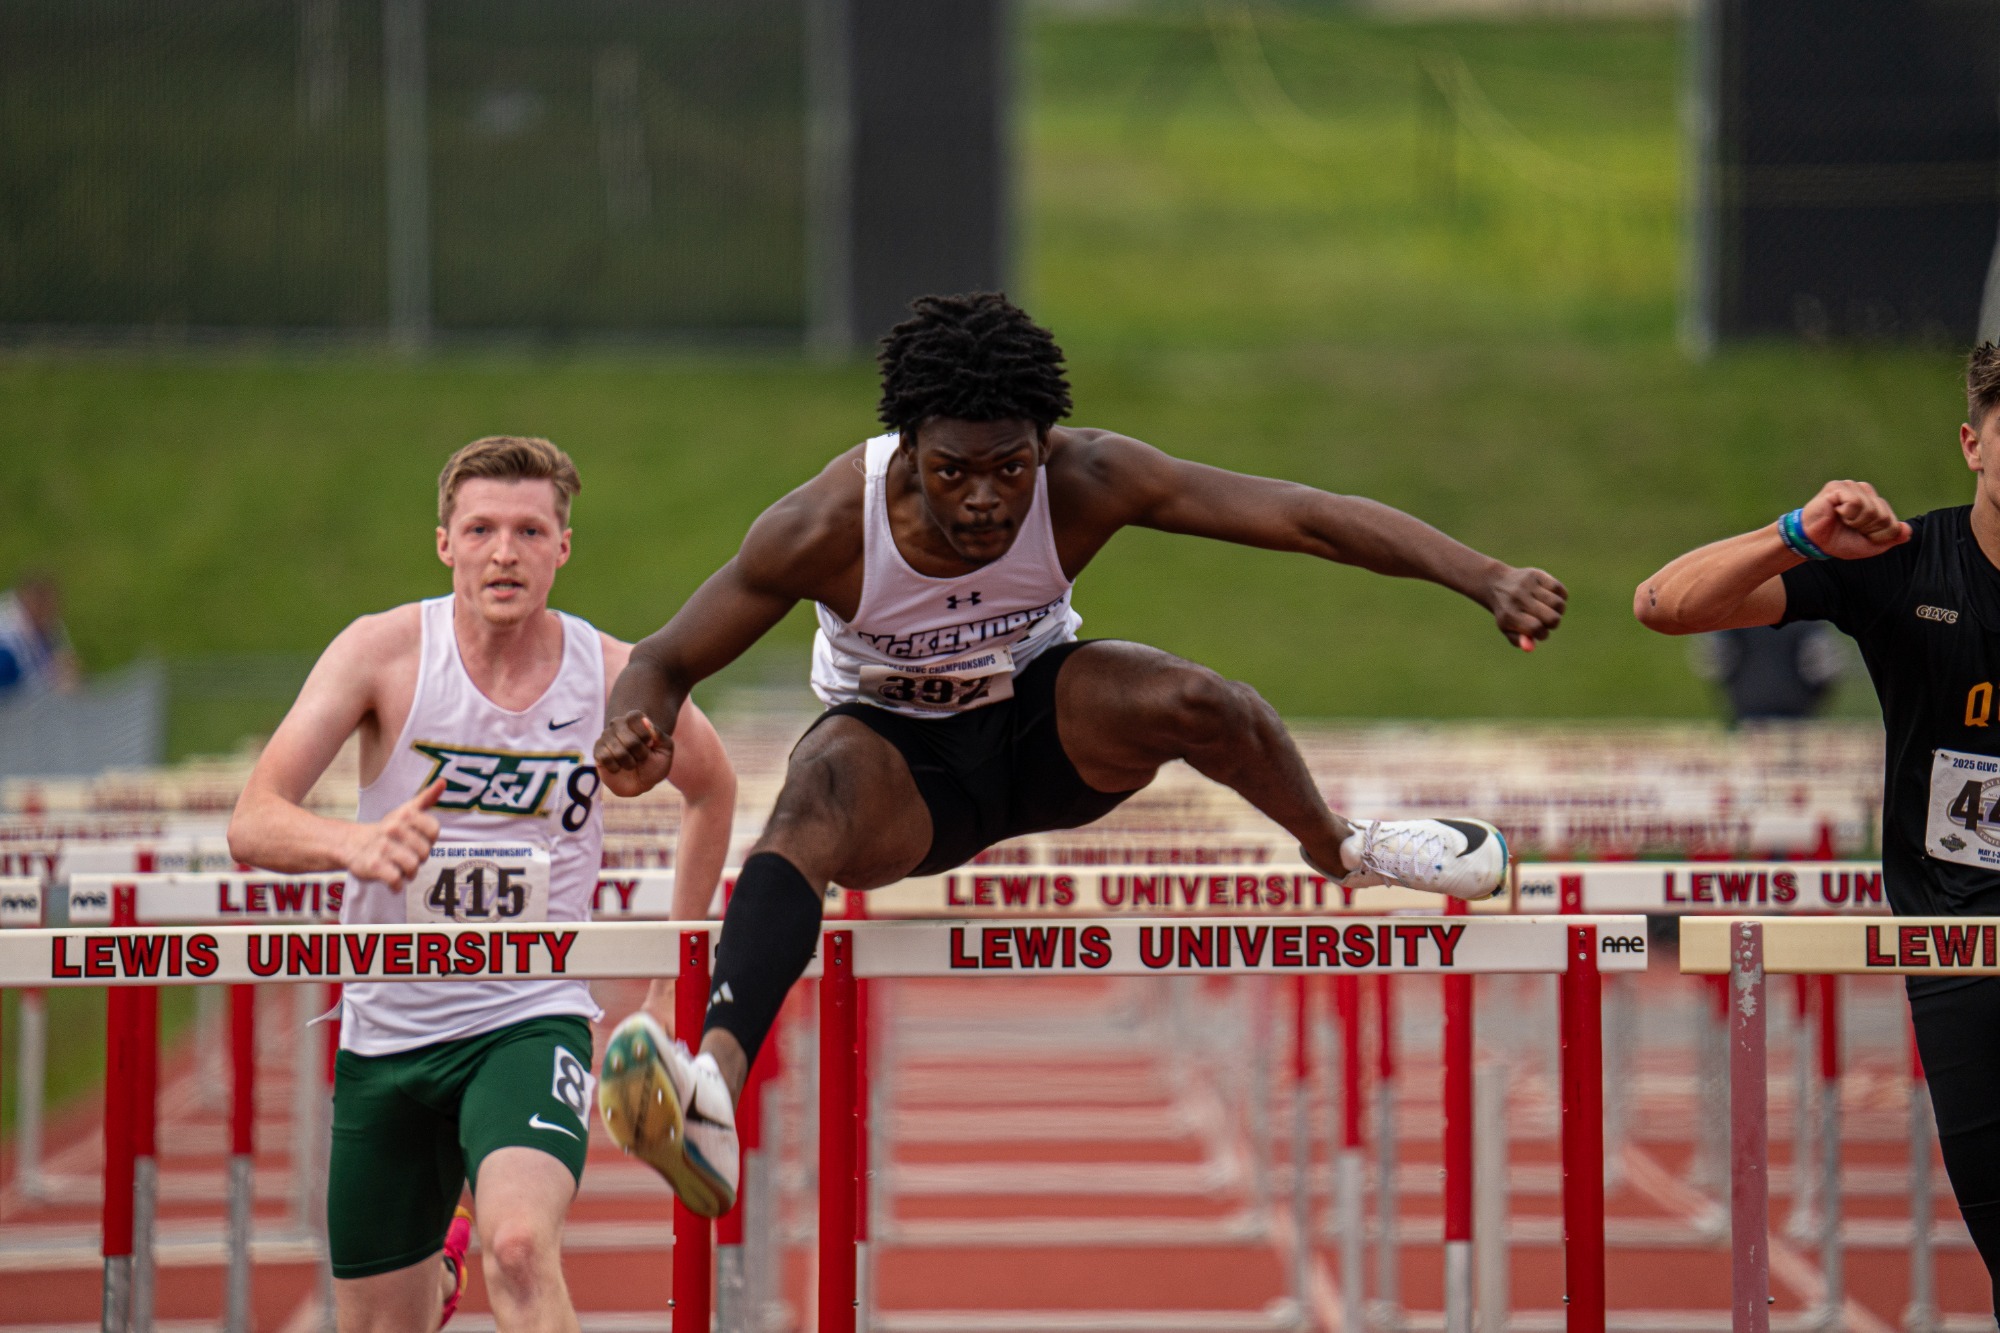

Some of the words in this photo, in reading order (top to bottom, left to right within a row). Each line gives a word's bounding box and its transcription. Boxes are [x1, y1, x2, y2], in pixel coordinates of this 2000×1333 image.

[1916, 605, 1958, 624] GLVC
[929, 654, 996, 675] CHAMPIONSHIPS
[884, 676, 989, 704] 392
[1965, 682, 2000, 727] Q
[438, 751, 570, 809] S&T
[1953, 758, 1975, 770] 2025
[1977, 762, 1998, 773] GLVC
[562, 766, 600, 832] 8
[469, 847, 533, 857] CHAMPIONSHIPS
[1978, 848, 1991, 857] MAY
[430, 867, 526, 917] 415
[946, 873, 1077, 907] LEWIS
[1664, 870, 1797, 905] LEWIS
[52, 934, 219, 978] LEWIS
[247, 930, 578, 976] UNIVERSITY
[950, 925, 1112, 969] LEWIS
[1139, 924, 1467, 968] UNIVERSITY
[557, 1056, 586, 1117] 8
